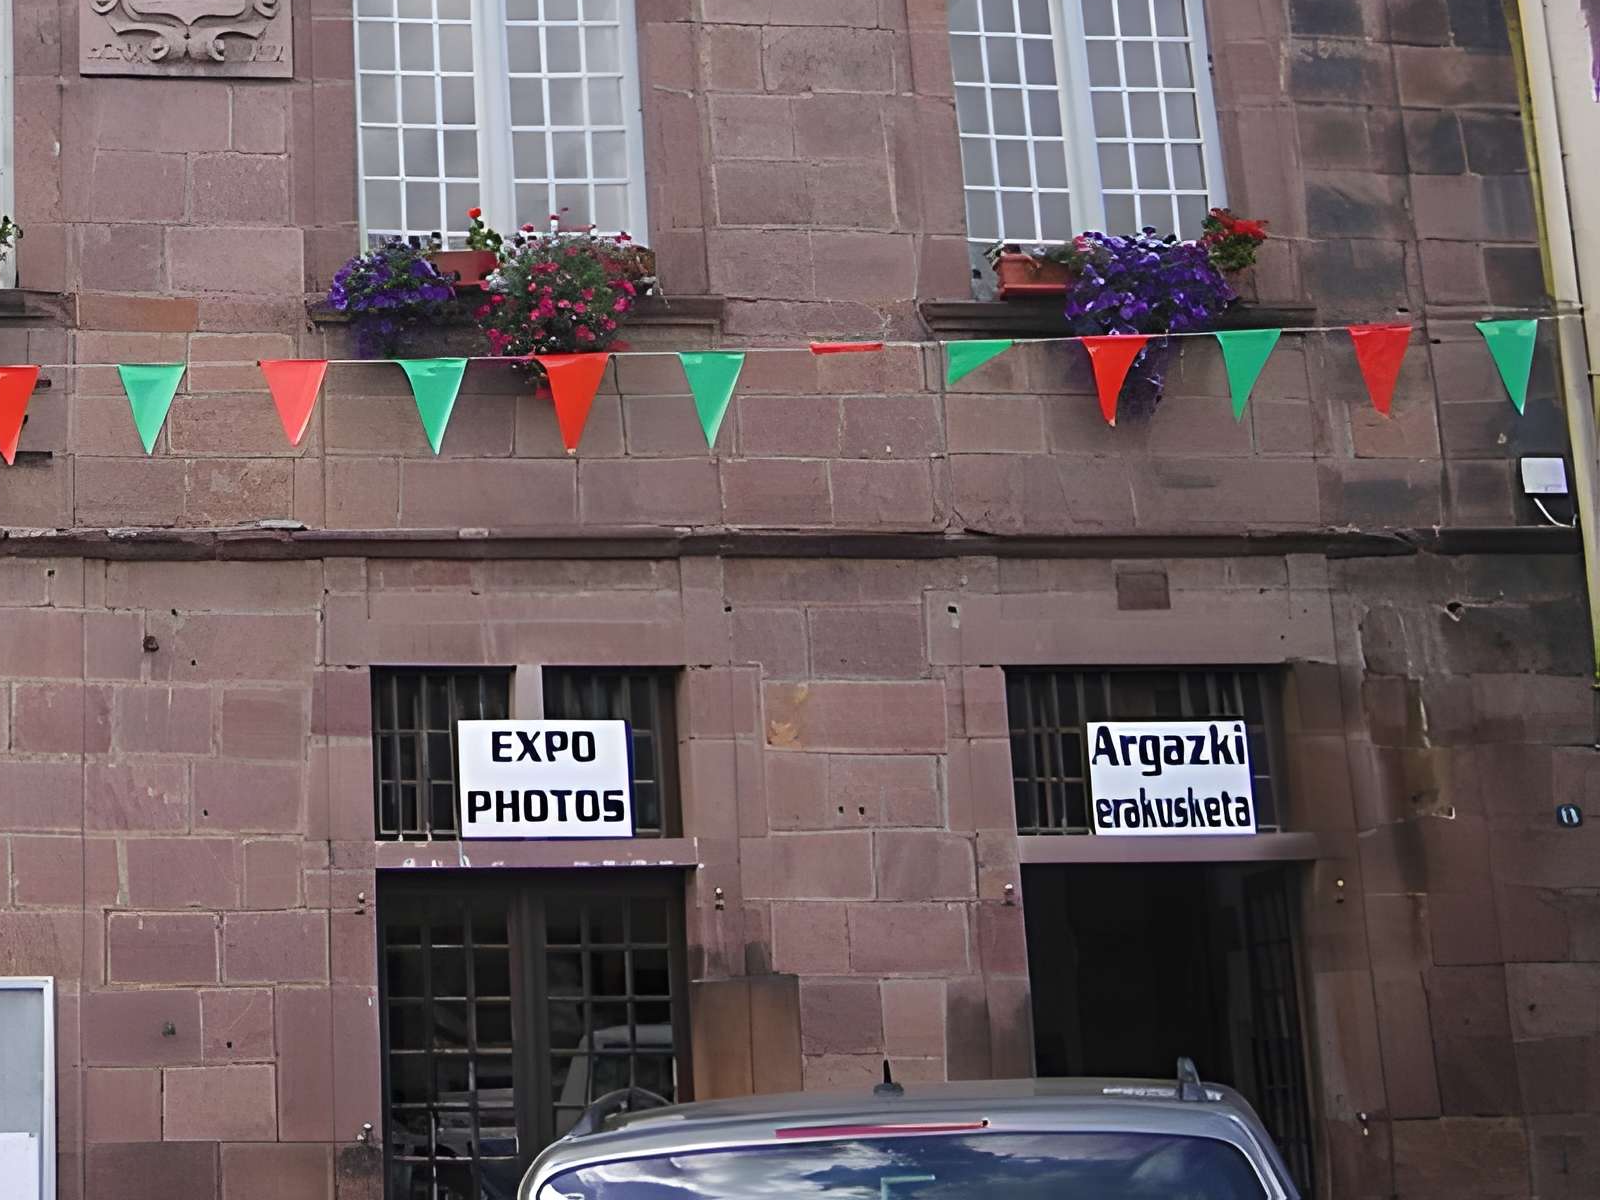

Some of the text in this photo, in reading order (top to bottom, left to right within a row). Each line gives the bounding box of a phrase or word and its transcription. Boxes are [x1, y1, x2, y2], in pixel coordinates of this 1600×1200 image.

[491, 730, 596, 762] EXPO
[1092, 724, 1246, 776] Argazki
[467, 790, 625, 823] PHOTOS
[1097, 787, 1251, 828] erakusketa
